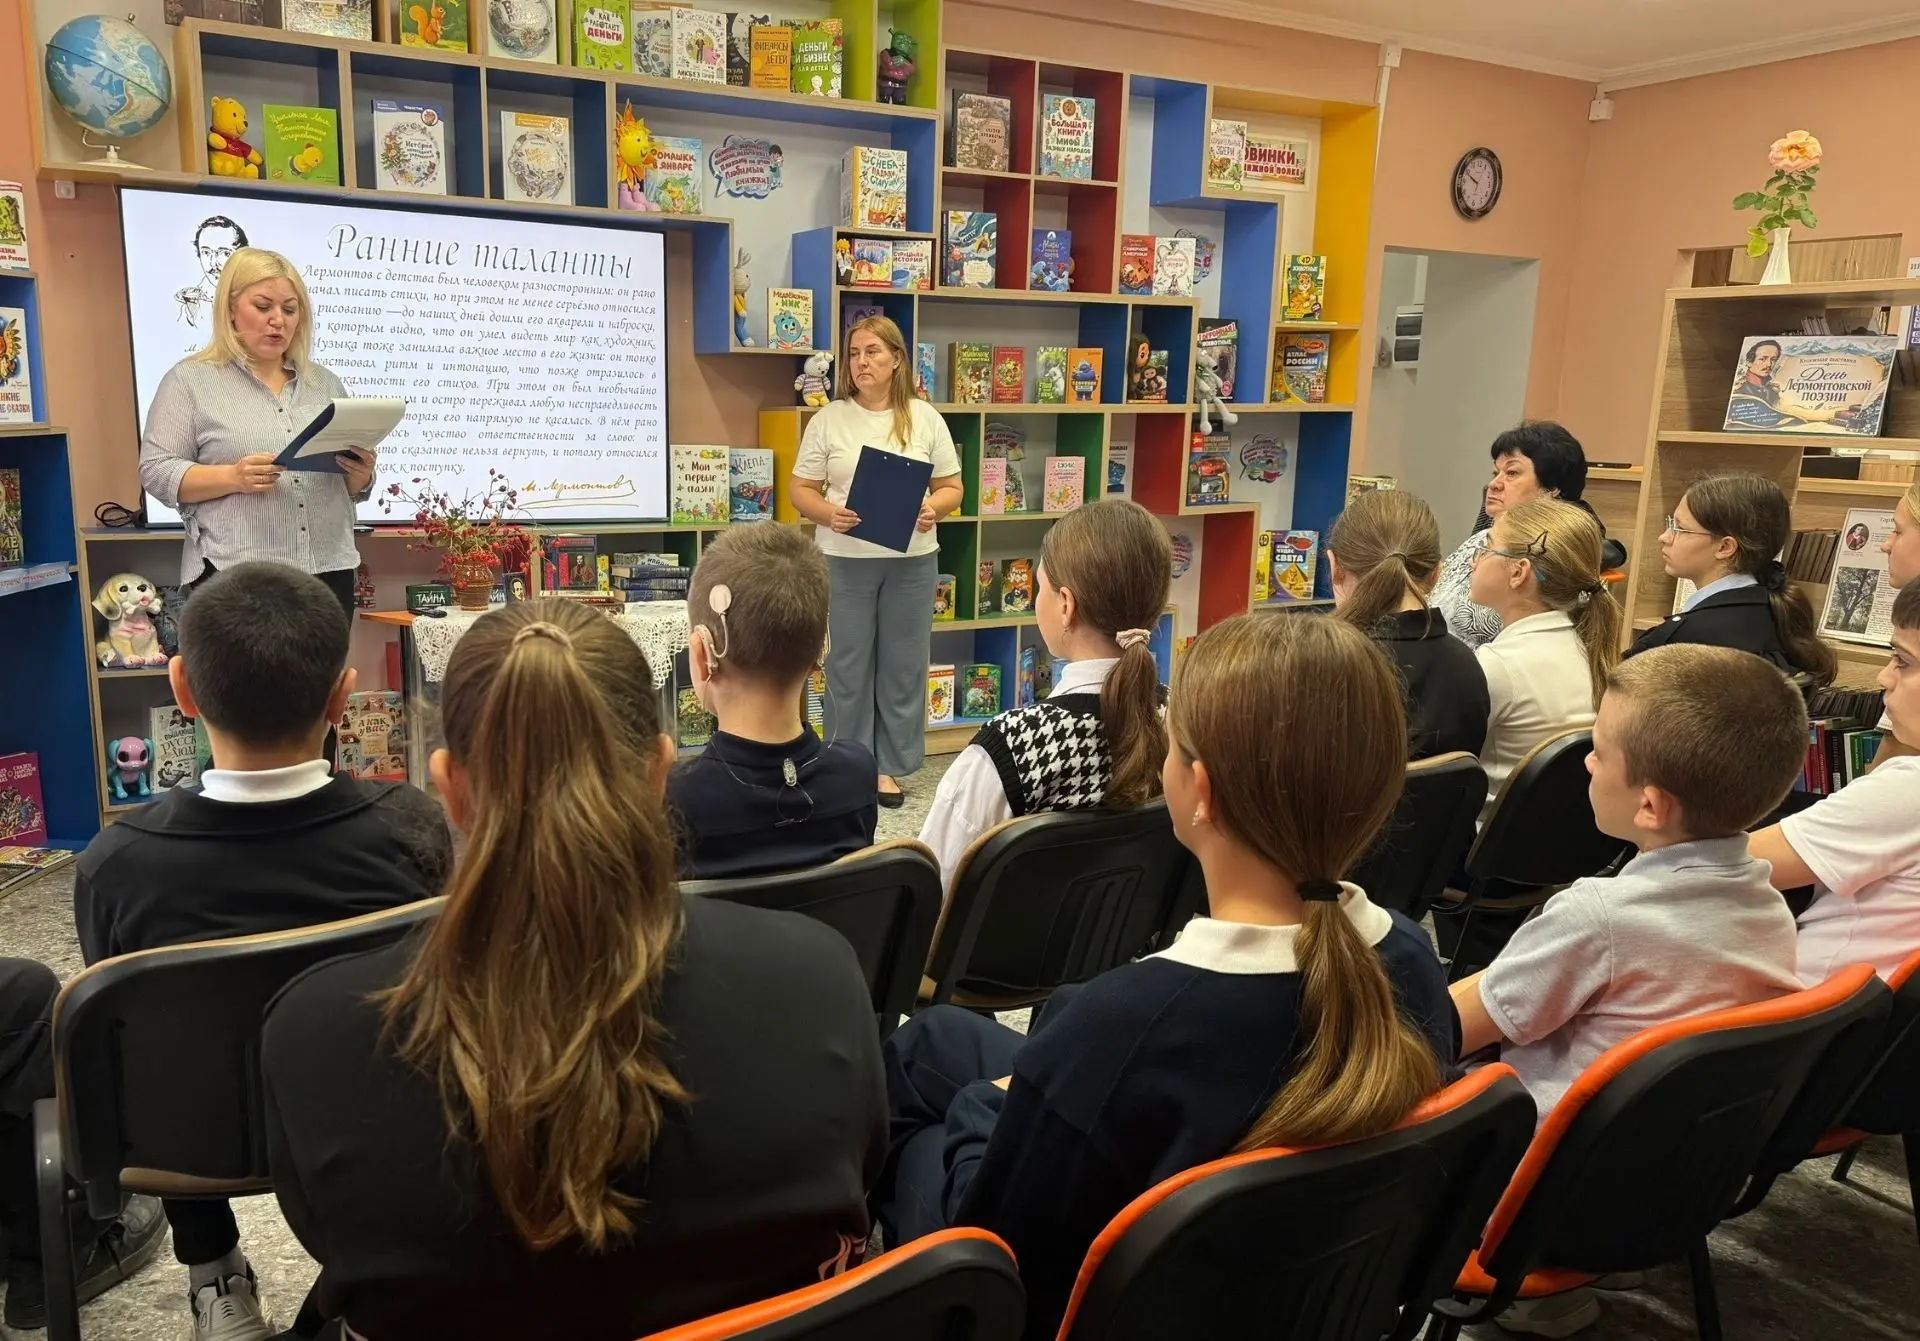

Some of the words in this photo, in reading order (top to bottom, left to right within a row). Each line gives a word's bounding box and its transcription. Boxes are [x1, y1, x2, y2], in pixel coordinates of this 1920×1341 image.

[599, 12, 609, 20] КАК
[588, 27, 622, 41] ДЕНЬГИ
[754, 41, 788, 51] ФИНАНСЫ
[799, 42, 827, 52] ДЕНЬГИ
[766, 55, 788, 65] ДЕТЕЙ
[796, 54, 800, 63] И
[804, 53, 831, 63] БИЗНЕС
[1051, 119, 1087, 129] БОЛЬШАЯ
[1058, 128, 1081, 136] КНИГА
[1057, 138, 1080, 146] МИФЫ
[651, 149, 696, 162] РОМАШКИ
[1245, 147, 1295, 164] ОВИНКИ
[659, 162, 692, 171] ЯНВАРЕ
[1244, 164, 1274, 173] ИЖНОЙ
[327, 224, 460, 265] Ранние
[474, 243, 632, 279] таланты
[303, 265, 373, 280] Лермонтов
[376, 271, 382, 280] с
[386, 268, 434, 283] детства
[438, 272, 460, 285] был
[463, 277, 519, 291] человеком
[523, 281, 613, 296] разносторонним:
[632, 289, 656, 300] рано
[344, 286, 386, 298] писать
[391, 290, 429, 302] стихи,
[434, 292, 446, 301] но
[450, 293, 471, 304] при
[474, 294, 504, 305] этом
[523, 299, 553, 308] менее
[556, 301, 600, 312] серьёзно
[603, 303, 656, 314] относился
[782, 300, 801, 308] НИК
[318, 304, 382, 318] рисованию
[420, 310, 457, 322] наших
[460, 308, 485, 321] дней
[490, 311, 523, 323] дошли
[528, 316, 543, 324] его
[548, 317, 594, 330] акварели
[609, 318, 655, 333] наброски,
[327, 322, 384, 335] которым
[390, 322, 426, 336] видно,
[433, 329, 454, 337] что
[460, 329, 473, 337] он
[478, 330, 506, 341] умел
[511, 330, 548, 341] видеть
[554, 334, 576, 346] мир
[582, 335, 601, 346] как
[363, 341, 394, 353] тоже
[399, 344, 454, 353] занимала
[459, 347, 499, 359] важное
[503, 348, 537, 357] место
[550, 351, 565, 359] его
[569, 352, 605, 362] жизни:
[626, 354, 656, 365] тонко
[385, 359, 417, 372] ритм
[427, 361, 433, 370] и
[443, 361, 510, 375] интонацию,
[519, 365, 539, 374] что
[548, 366, 578, 378] позже
[586, 369, 644, 380] отразилось
[1801, 367, 1847, 381] День
[341, 376, 405, 386] кальности
[437, 381, 479, 390] стихов.
[486, 379, 510, 393] При
[553, 384, 565, 392] он
[572, 381, 592, 393] был
[599, 383, 657, 397] необычайно
[1783, 379, 1872, 392] Лермонтовской
[1802, 392, 1847, 402] поэзии
[432, 396, 465, 408] остро
[470, 397, 526, 409] переживал
[530, 396, 565, 411] любую
[569, 399, 657, 412] несправедливость
[403, 413, 438, 424] торая
[444, 414, 460, 422] его
[466, 414, 523, 427] напрямую
[545, 417, 592, 427] касалась.
[597, 416, 606, 425] В
[611, 418, 629, 426] нём
[635, 419, 657, 429] рано
[422, 430, 467, 441] чувство
[478, 431, 574, 441] ответственности
[647, 434, 657, 442] он
[402, 446, 458, 457] сказанное
[462, 447, 497, 456] нельзя
[503, 449, 547, 459] вернуть,
[564, 449, 602, 460] потому
[606, 450, 657, 458] относился
[410, 463, 465, 474] поступку.
[692, 462, 710, 471] Мои
[685, 474, 716, 483] первые
[416, 591, 446, 604] ТАЙНА
[489, 589, 505, 602] АЙН
[161, 736, 196, 754] РУССК
